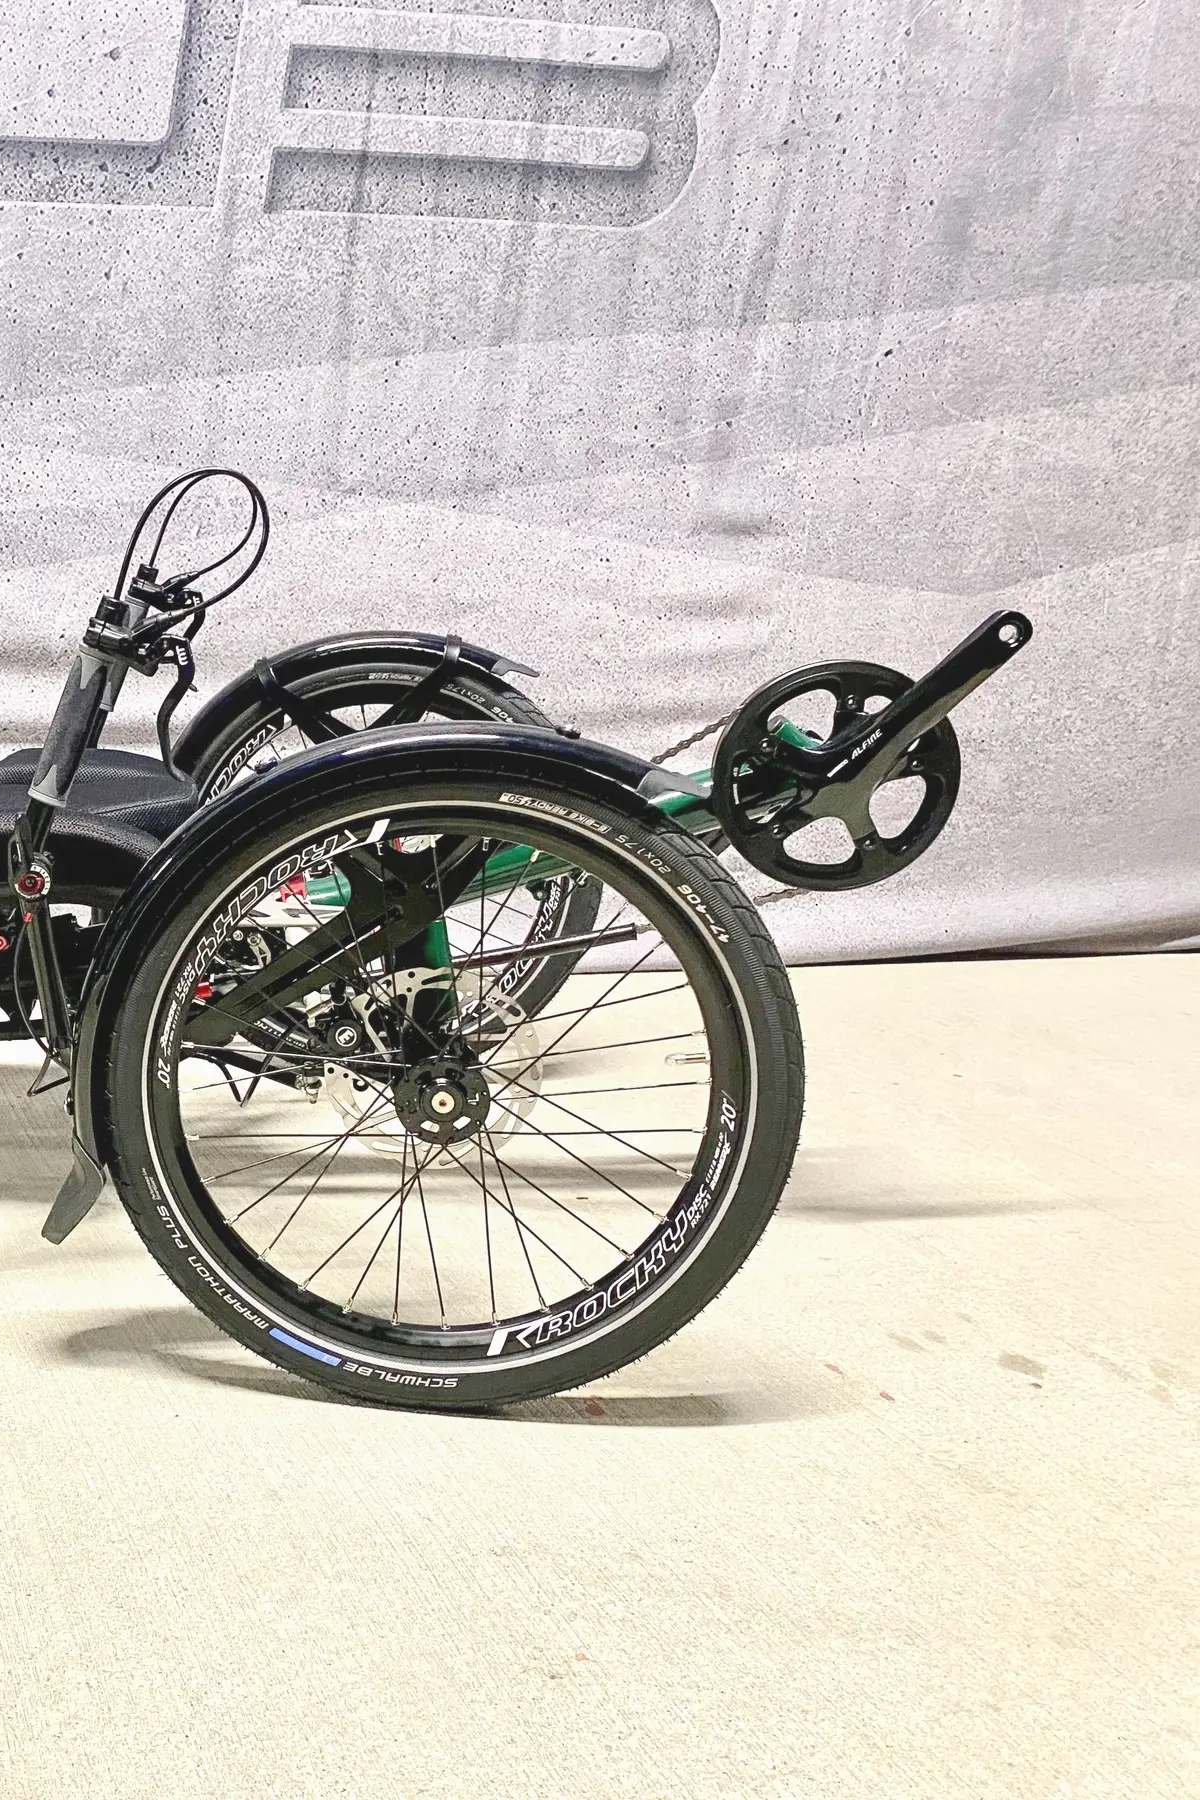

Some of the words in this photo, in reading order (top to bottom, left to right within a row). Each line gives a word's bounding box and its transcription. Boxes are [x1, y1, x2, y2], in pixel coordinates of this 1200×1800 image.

[851, 728, 883, 760] ALFINE
[195, 834, 340, 976] ROCKY
[676, 883, 730, 943] 47-406
[174, 978, 186, 998] 721
[179, 968, 196, 1005] DISC
[182, 962, 193, 980] RX
[687, 1184, 707, 1221] DISC
[690, 1214, 702, 1228] RX
[700, 1193, 712, 1214] 721
[157, 1204, 189, 1250] PLUS
[187, 1254, 270, 1330] MARATHON
[534, 1210, 688, 1345] ROCKY
[342, 1362, 460, 1389] SCHWALBE
